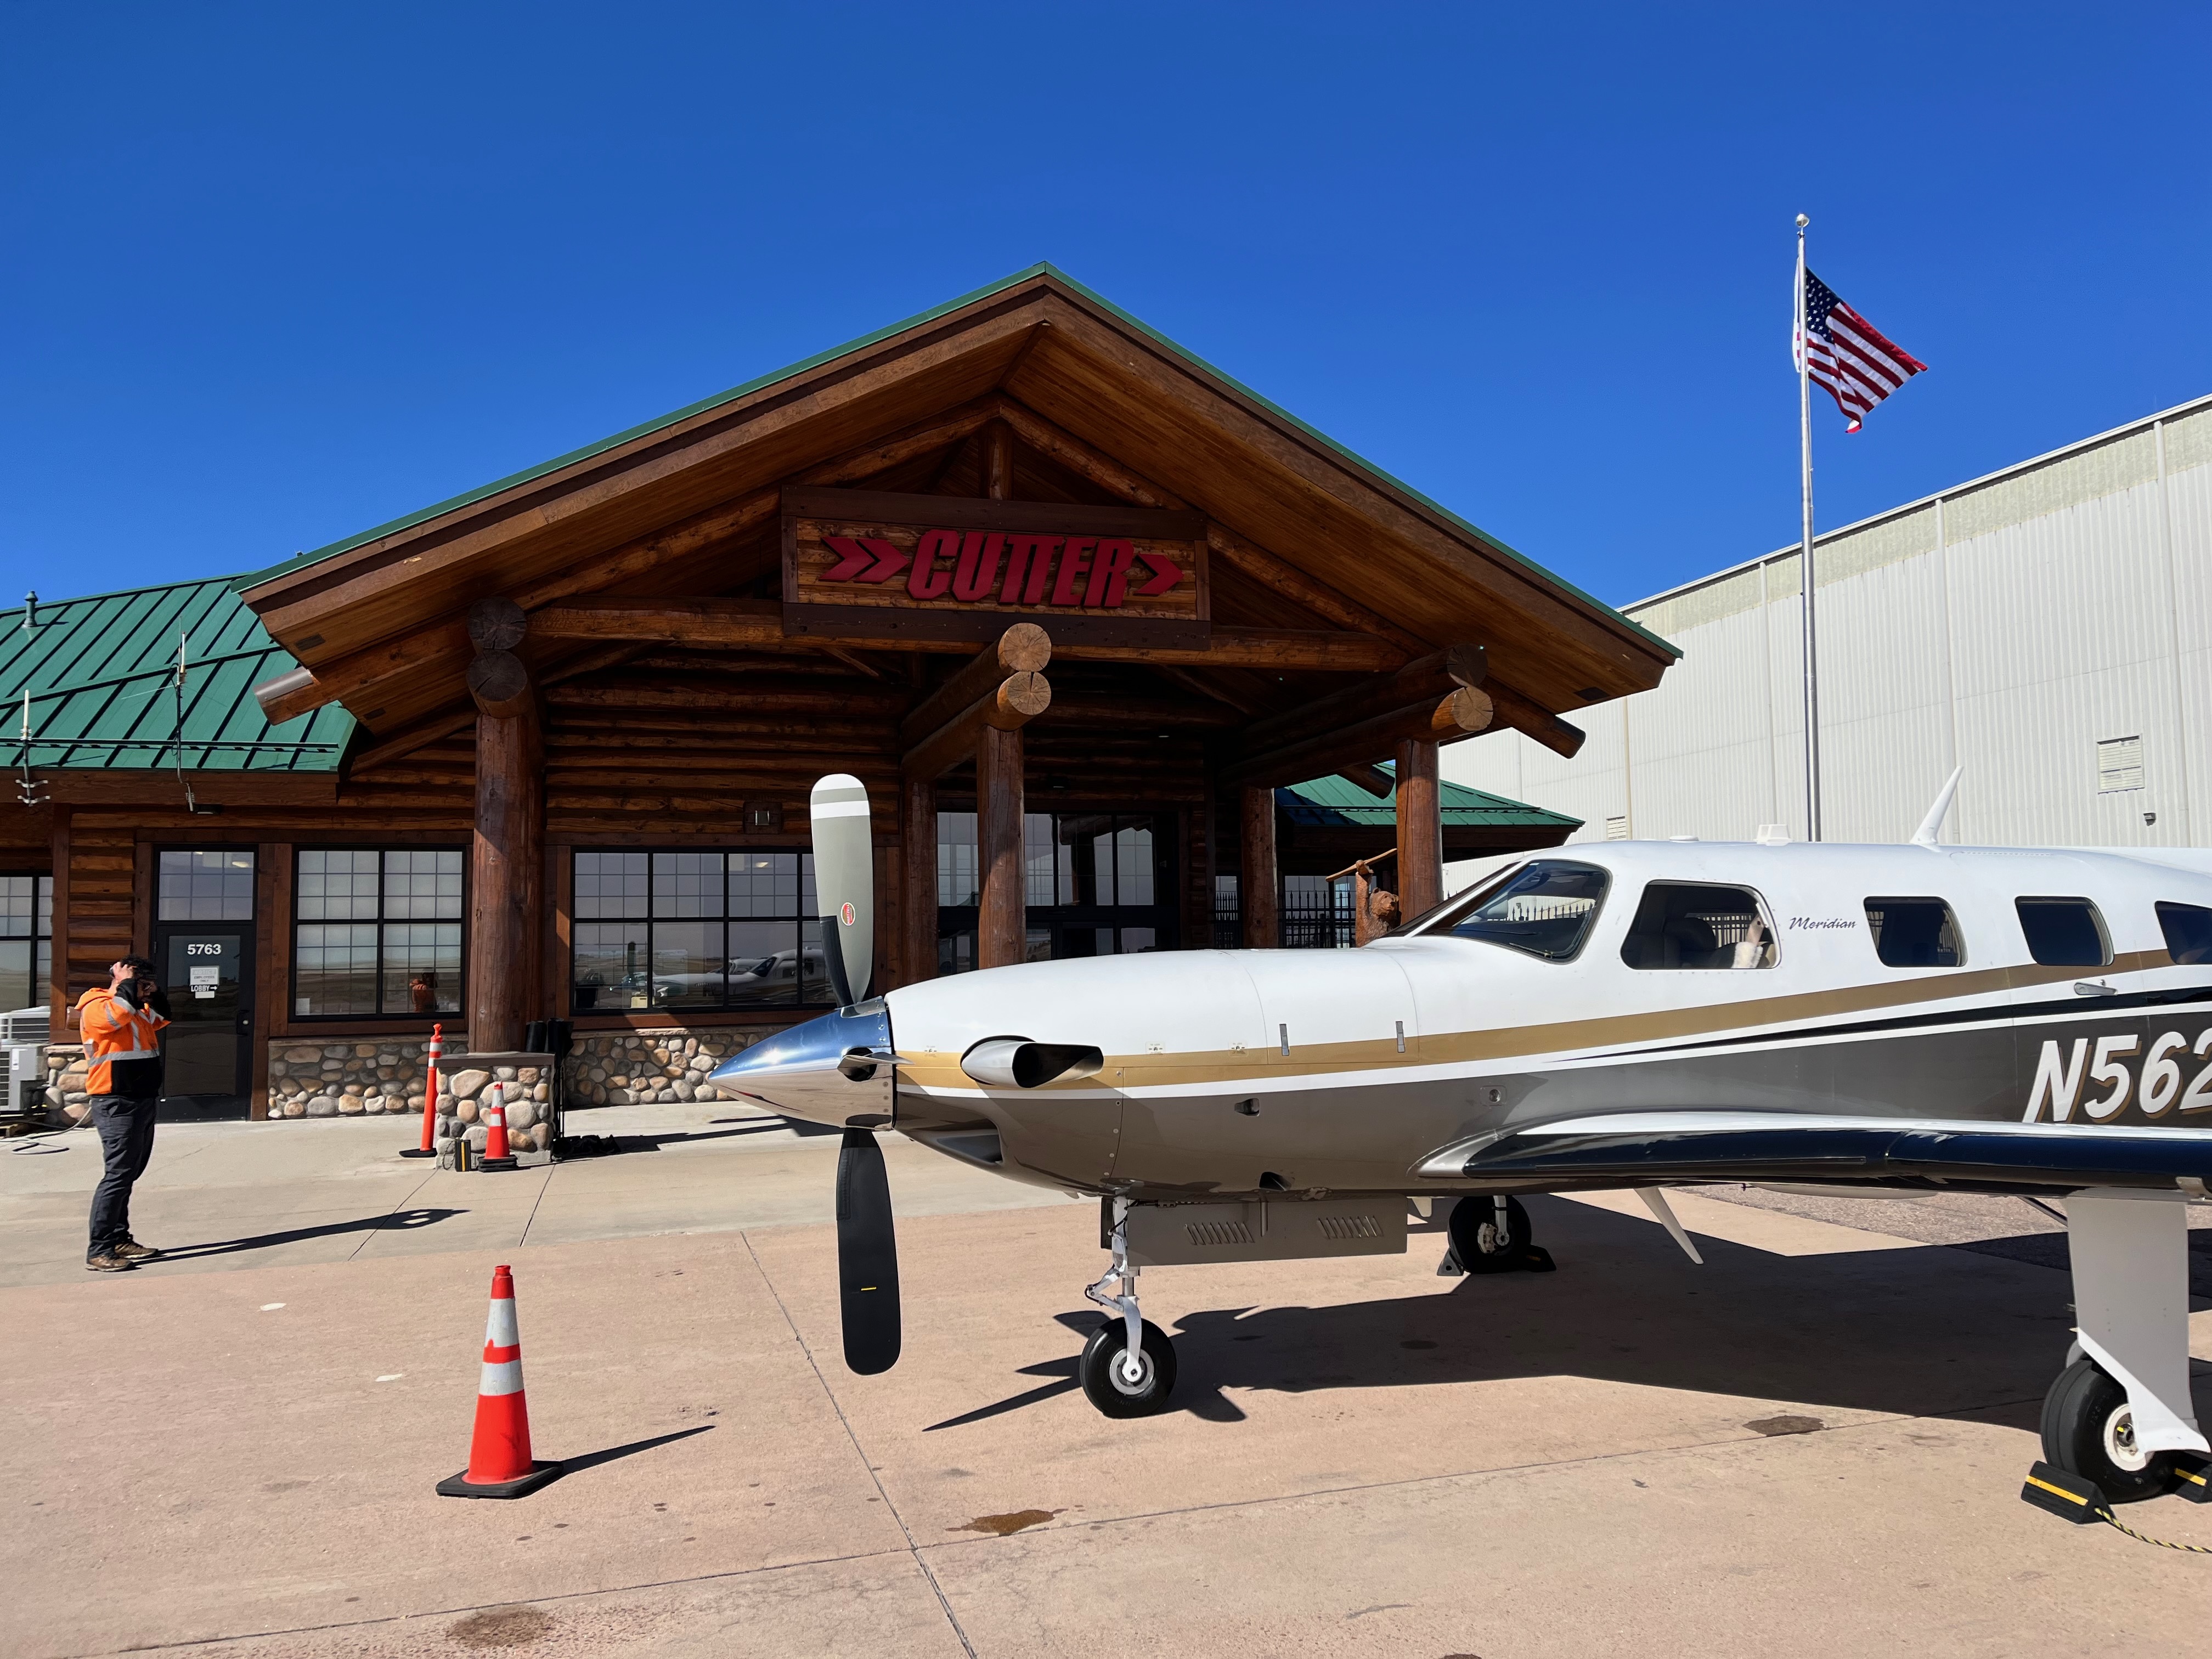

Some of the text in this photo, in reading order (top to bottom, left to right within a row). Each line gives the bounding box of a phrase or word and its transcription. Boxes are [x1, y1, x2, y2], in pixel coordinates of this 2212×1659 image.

[906, 529, 1135, 608] CUTTER
[1788, 917, 1857, 930] Meridian
[187, 944, 221, 955] 5763
